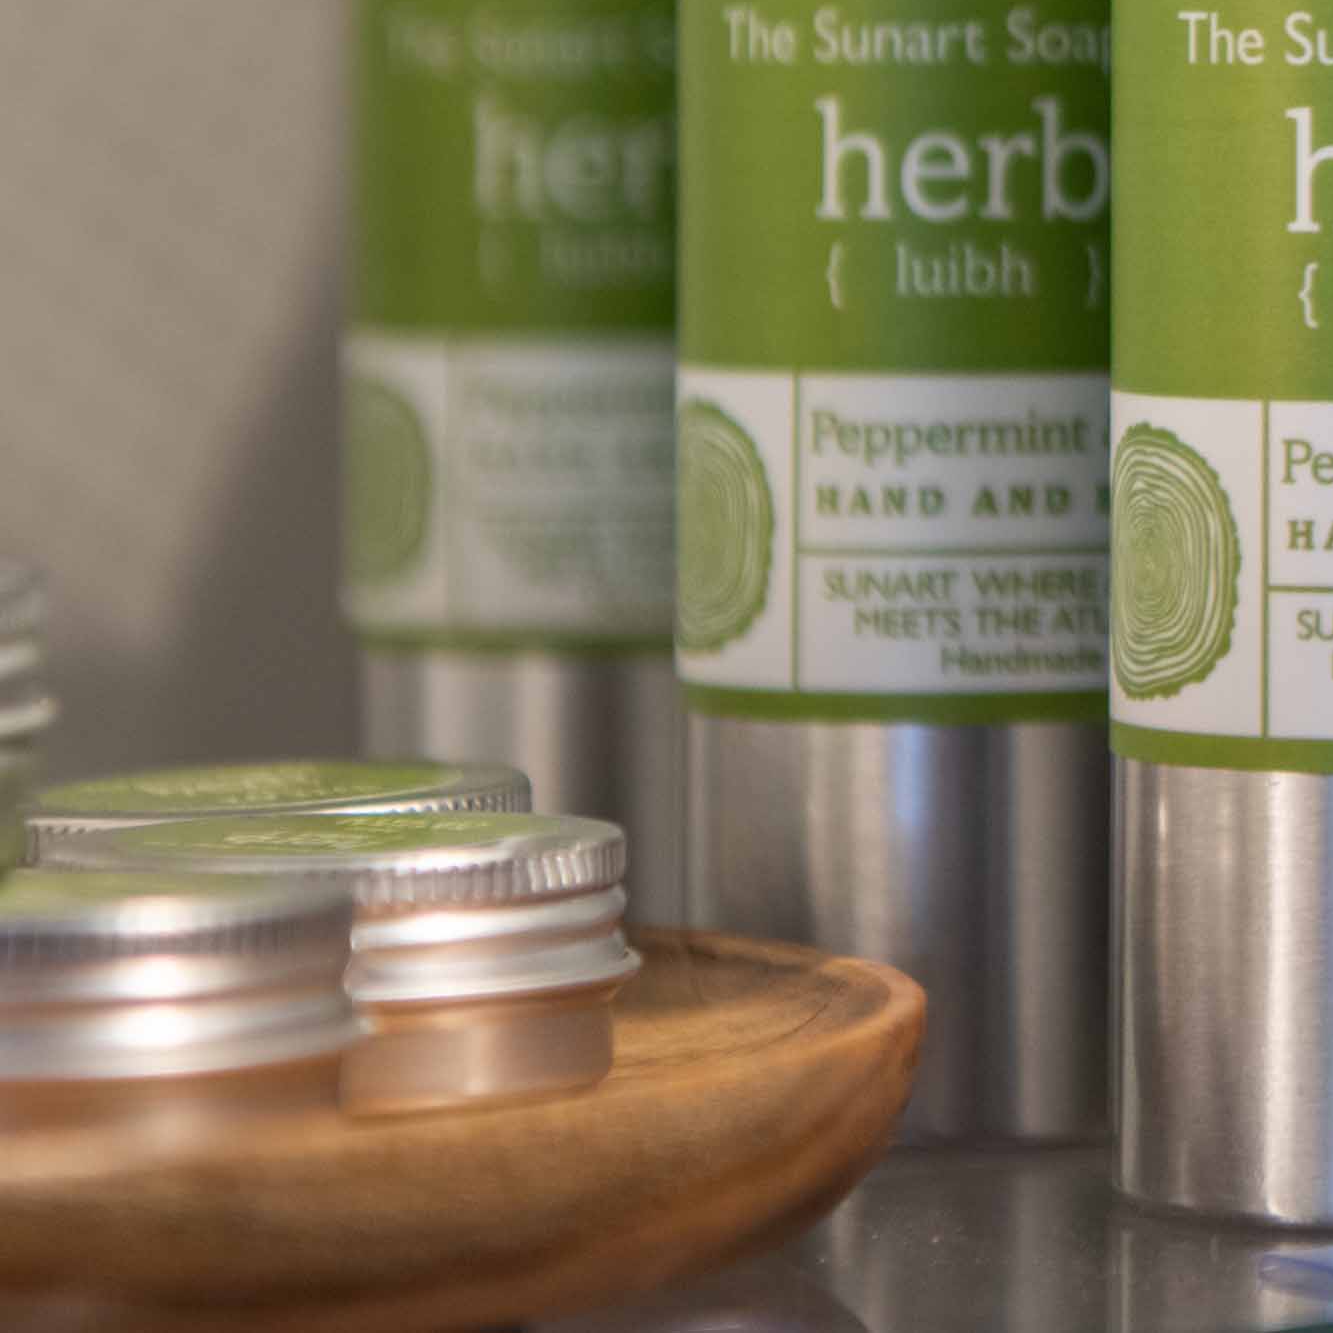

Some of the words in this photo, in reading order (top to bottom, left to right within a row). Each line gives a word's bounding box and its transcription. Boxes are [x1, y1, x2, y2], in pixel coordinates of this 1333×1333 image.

[723, 5, 796, 64] The
[813, 7, 986, 65] Sunart
[1178, 11, 1265, 65] The
[814, 96, 1109, 222] herb
[895, 242, 1035, 297] luibh
[811, 409, 1088, 468] Peppermint
[815, 485, 945, 516] HAND
[971, 484, 1072, 515] AND
